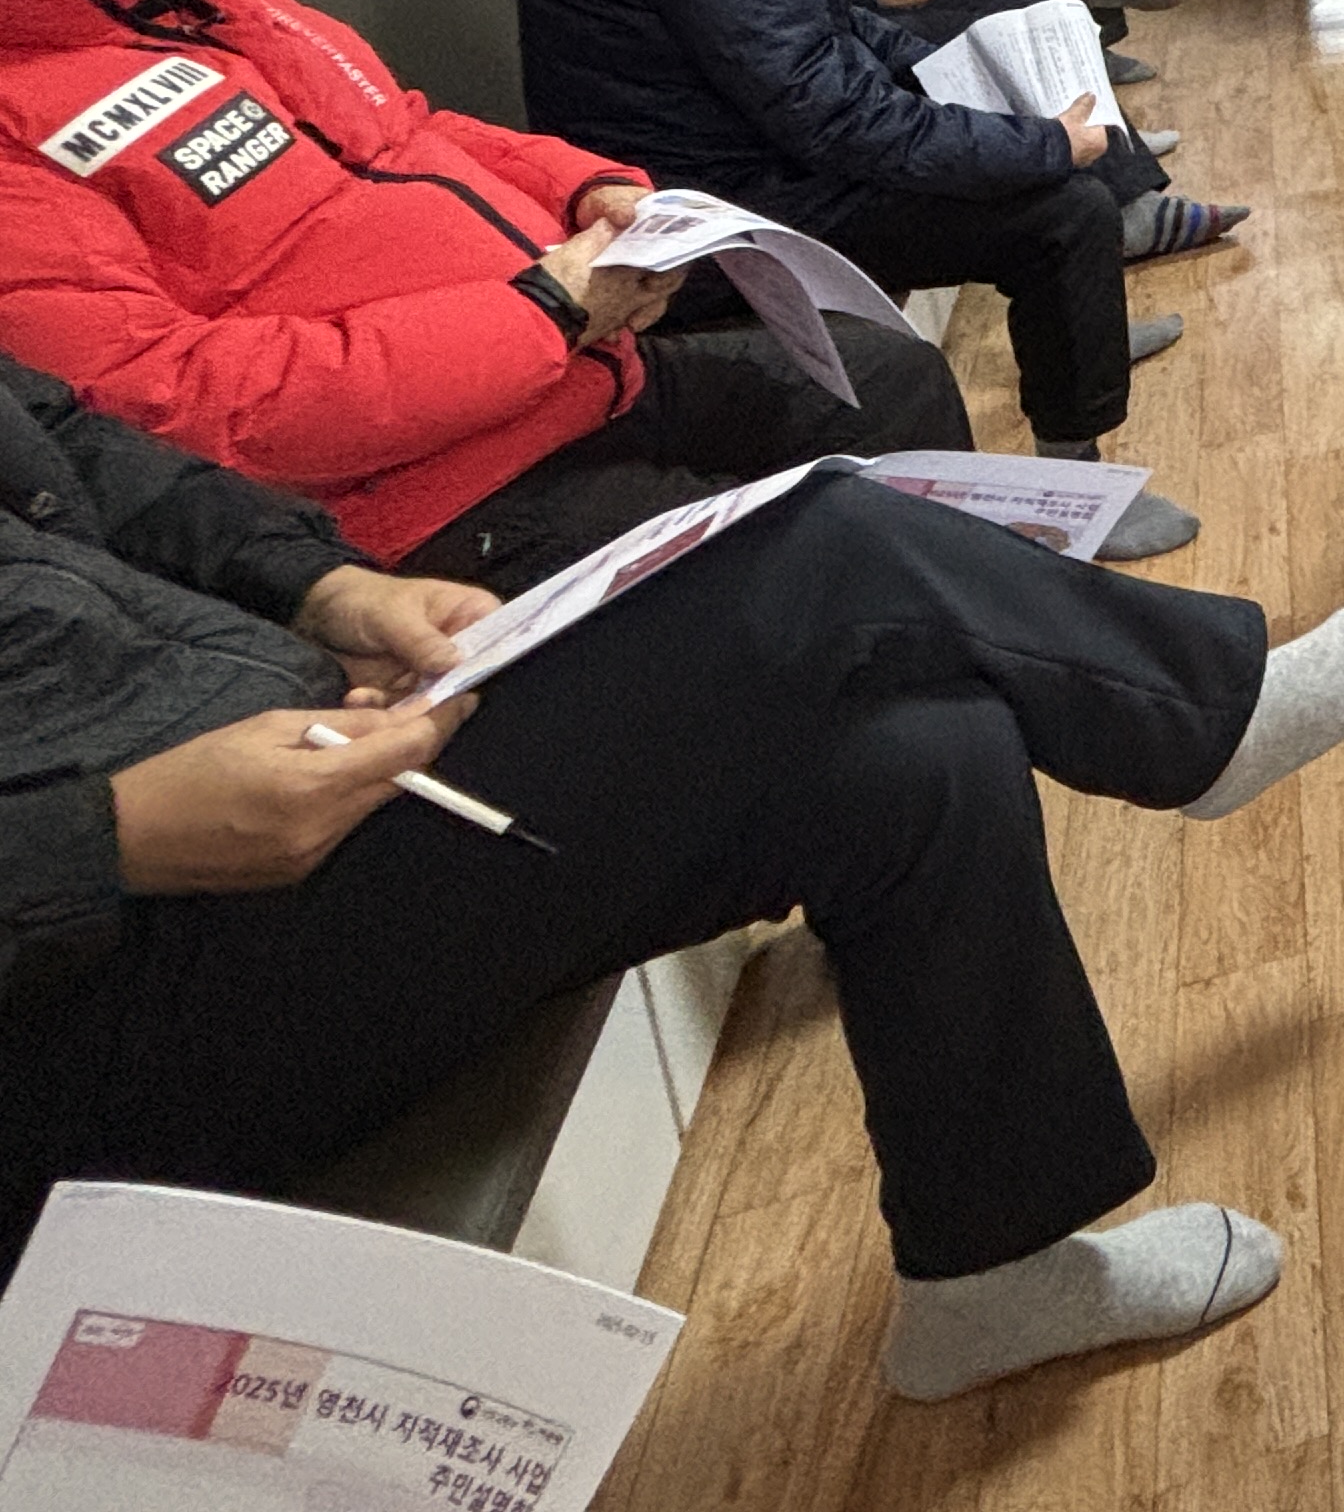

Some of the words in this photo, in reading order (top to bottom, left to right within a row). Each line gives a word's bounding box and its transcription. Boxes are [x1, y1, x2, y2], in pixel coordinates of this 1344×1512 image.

[61, 61, 209, 163] MCMXLVIII
[174, 109, 254, 170] SPACE
[199, 121, 291, 196] RANGER
[316, 1387, 391, 1433] 영천시
[392, 1411, 506, 1474] 지적재조사
[505, 1454, 552, 1497] 사업
